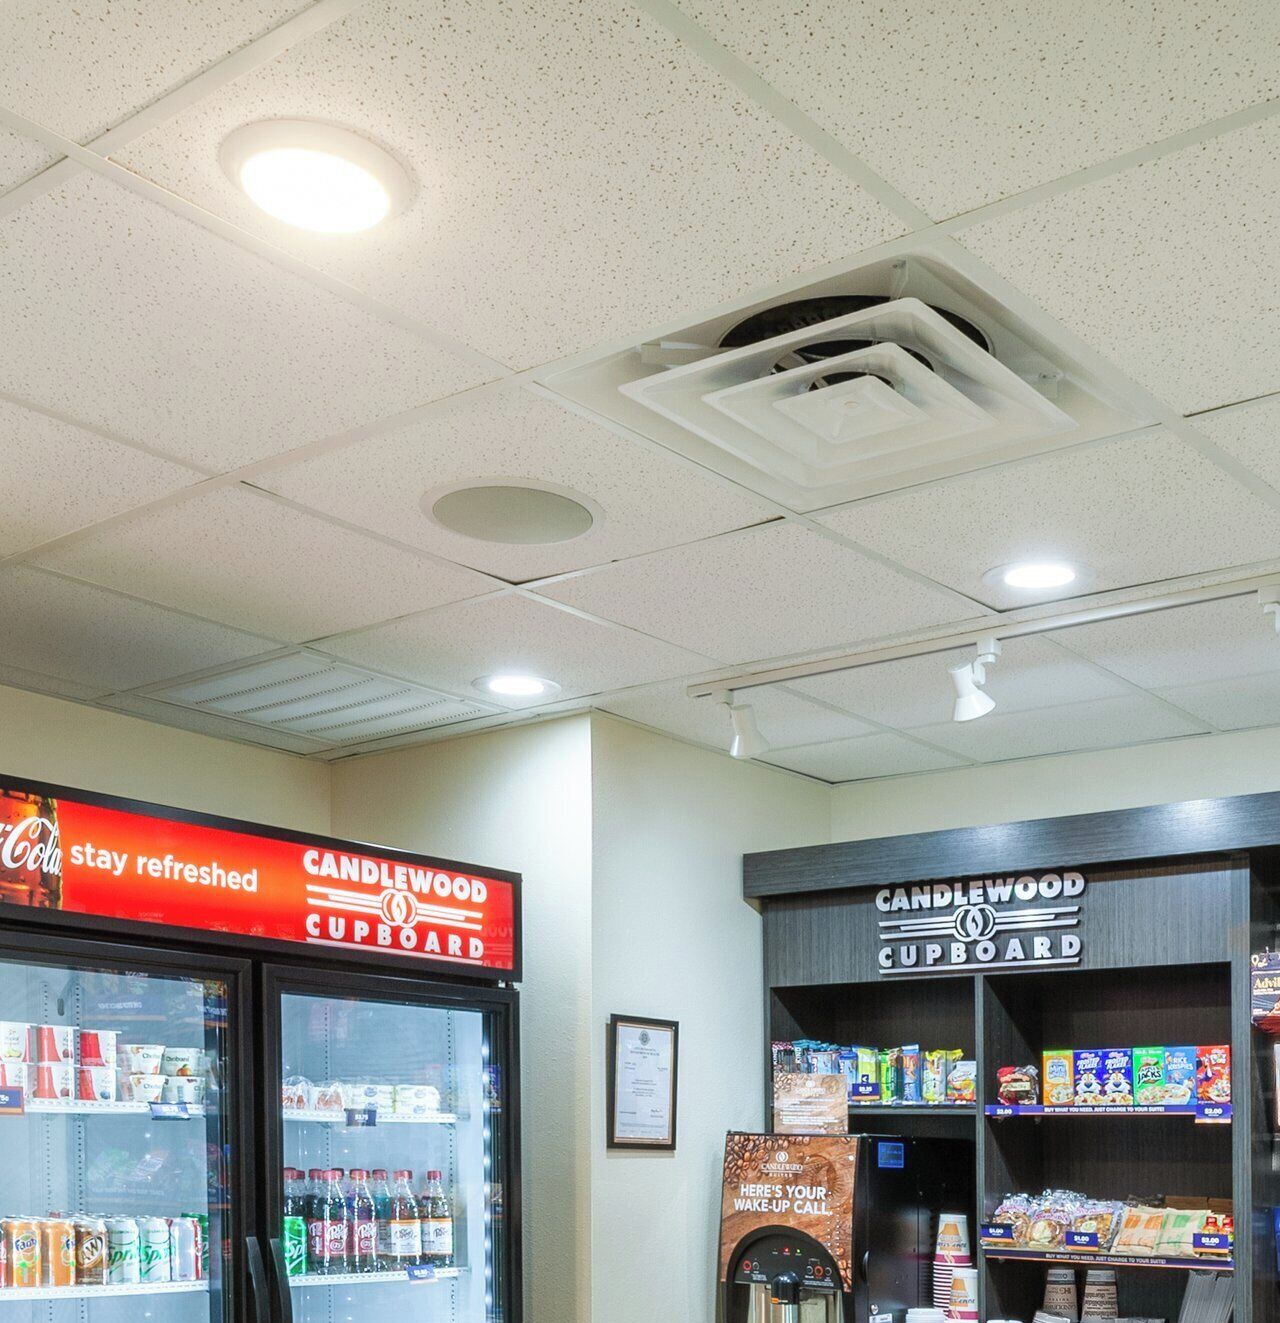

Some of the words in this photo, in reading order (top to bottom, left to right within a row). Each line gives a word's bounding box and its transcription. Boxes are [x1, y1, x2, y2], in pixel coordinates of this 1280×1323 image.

[71, 844, 127, 877] stay
[136, 854, 258, 893] refreshed
[303, 849, 487, 904] CANDLEWOOD
[875, 872, 1085, 912] CANDLEWOOD
[306, 913, 484, 959] CUPBOARD
[878, 935, 1081, 968] CUPBOARD
[1254, 977, 1280, 988] Advil
[761, 1163, 803, 1171] CANDLEWOOD
[734, 1201, 791, 1212] WAKE-UP
[794, 1201, 833, 1215] CALL.
[741, 1184, 782, 1197] HERE'S
[786, 1185, 826, 1200] YOUR
